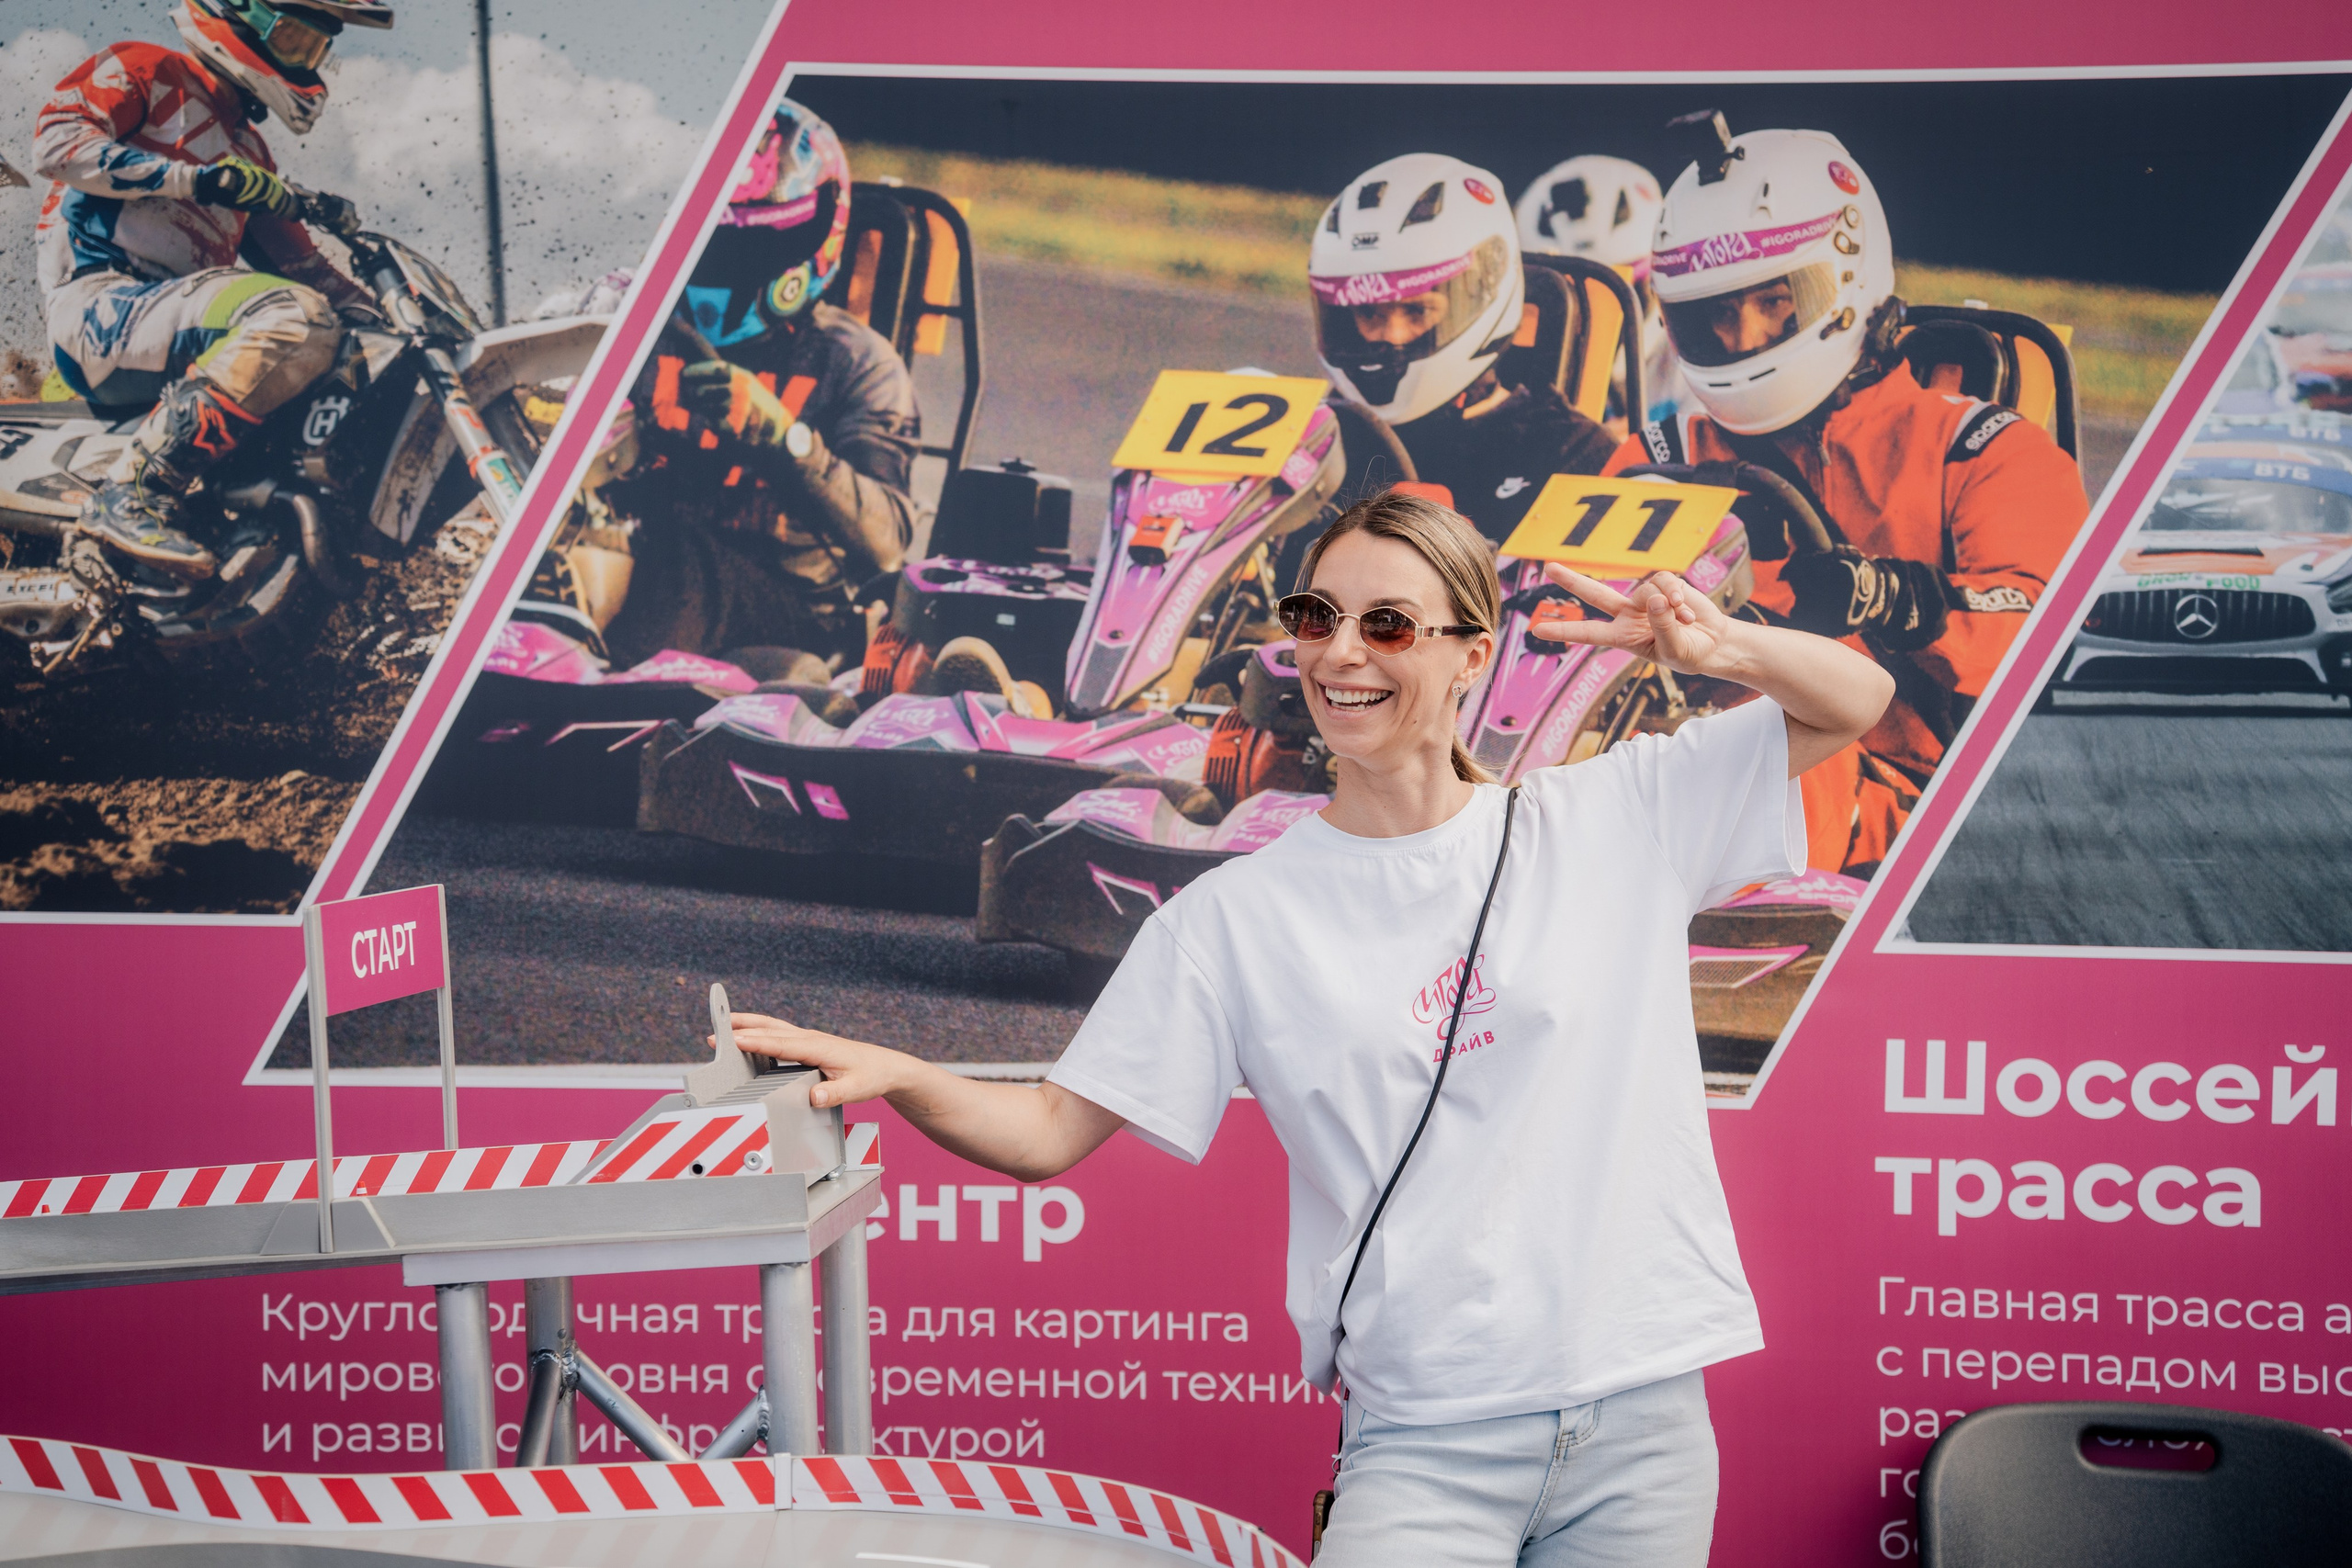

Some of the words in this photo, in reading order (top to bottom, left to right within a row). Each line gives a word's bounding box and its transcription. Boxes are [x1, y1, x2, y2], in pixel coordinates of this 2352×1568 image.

[1760, 216, 1839, 249] #IGORADRIV
[1163, 393, 1290, 457] 12
[1560, 493, 1684, 553] 11
[1147, 564, 1210, 664] #IGORADRIVE
[1541, 659, 1608, 759] #IGORADRIVE
[1797, 891, 1861, 906] SPOR
[351, 920, 417, 979] СТАРТ
[1432, 1030, 1496, 1064] ДРАЙВ
[1884, 1038, 2352, 1127] Шоссей
[1874, 1156, 2262, 1237] трасса
[901, 1306, 996, 1343] для
[1014, 1307, 1250, 1349] картинга
[1879, 1276, 2099, 1324] Главная
[2116, 1292, 2305, 1336] трасса
[262, 1361, 526, 1402] мирово
[576, 1362, 729, 1402] овня
[817, 1359, 1148, 1406] ременной
[1876, 1345, 1905, 1377] с
[1921, 1347, 2237, 1394] перепадом
[262, 1423, 292, 1453] и
[312, 1422, 523, 1462] разво
[1880, 1405, 1967, 1447] ра
[1879, 1518, 1918, 1561] б
